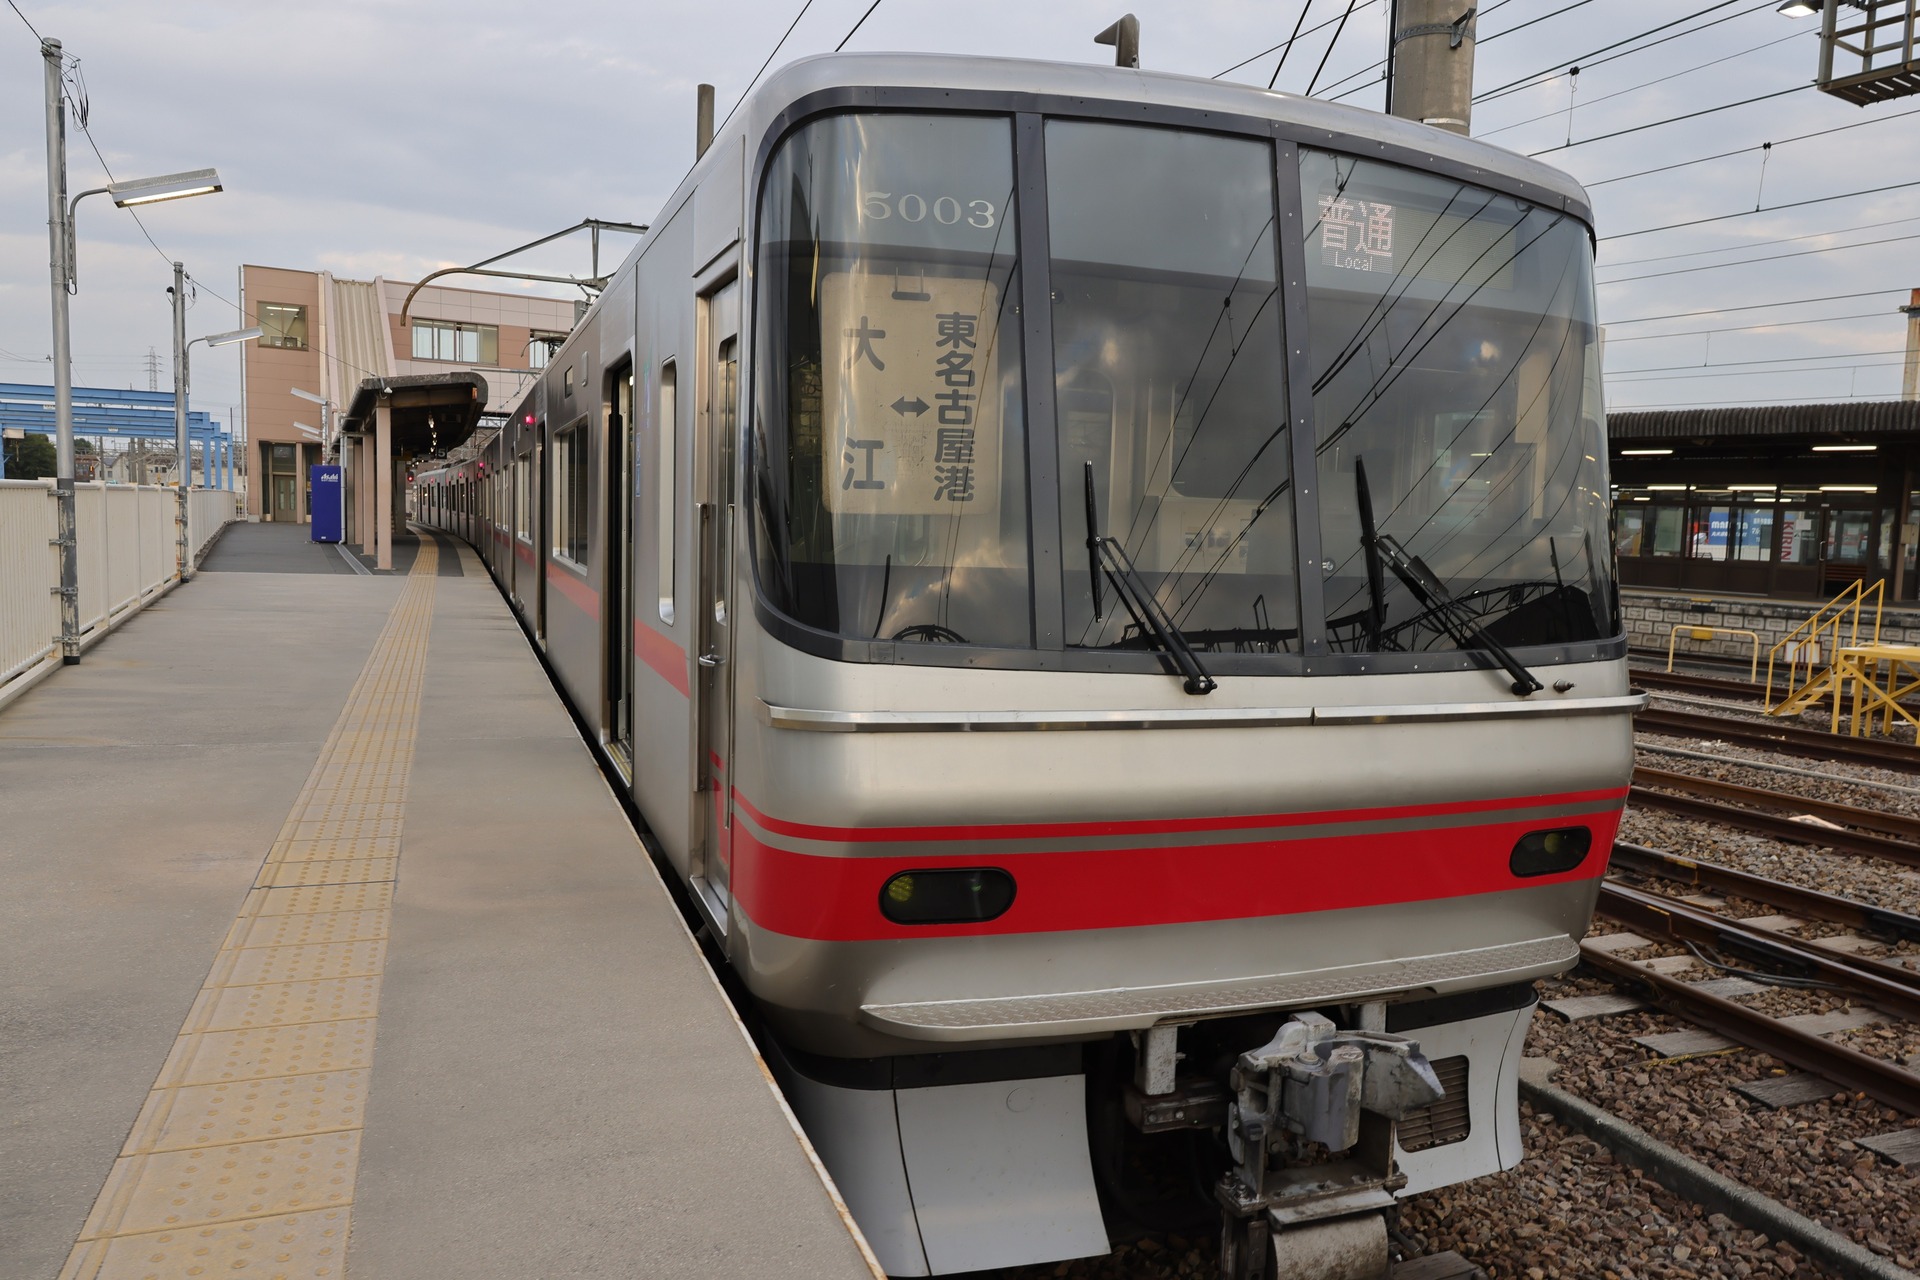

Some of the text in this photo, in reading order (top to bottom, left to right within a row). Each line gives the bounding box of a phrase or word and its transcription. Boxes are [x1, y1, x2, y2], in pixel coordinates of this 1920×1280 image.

[863, 191, 995, 228] 5003
[1318, 195, 1393, 257] 普通
[1335, 251, 1373, 271] Local
[843, 316, 886, 490] 大江
[934, 312, 977, 501] 東名古屋港
[1781, 521, 1795, 561] KIRIN
